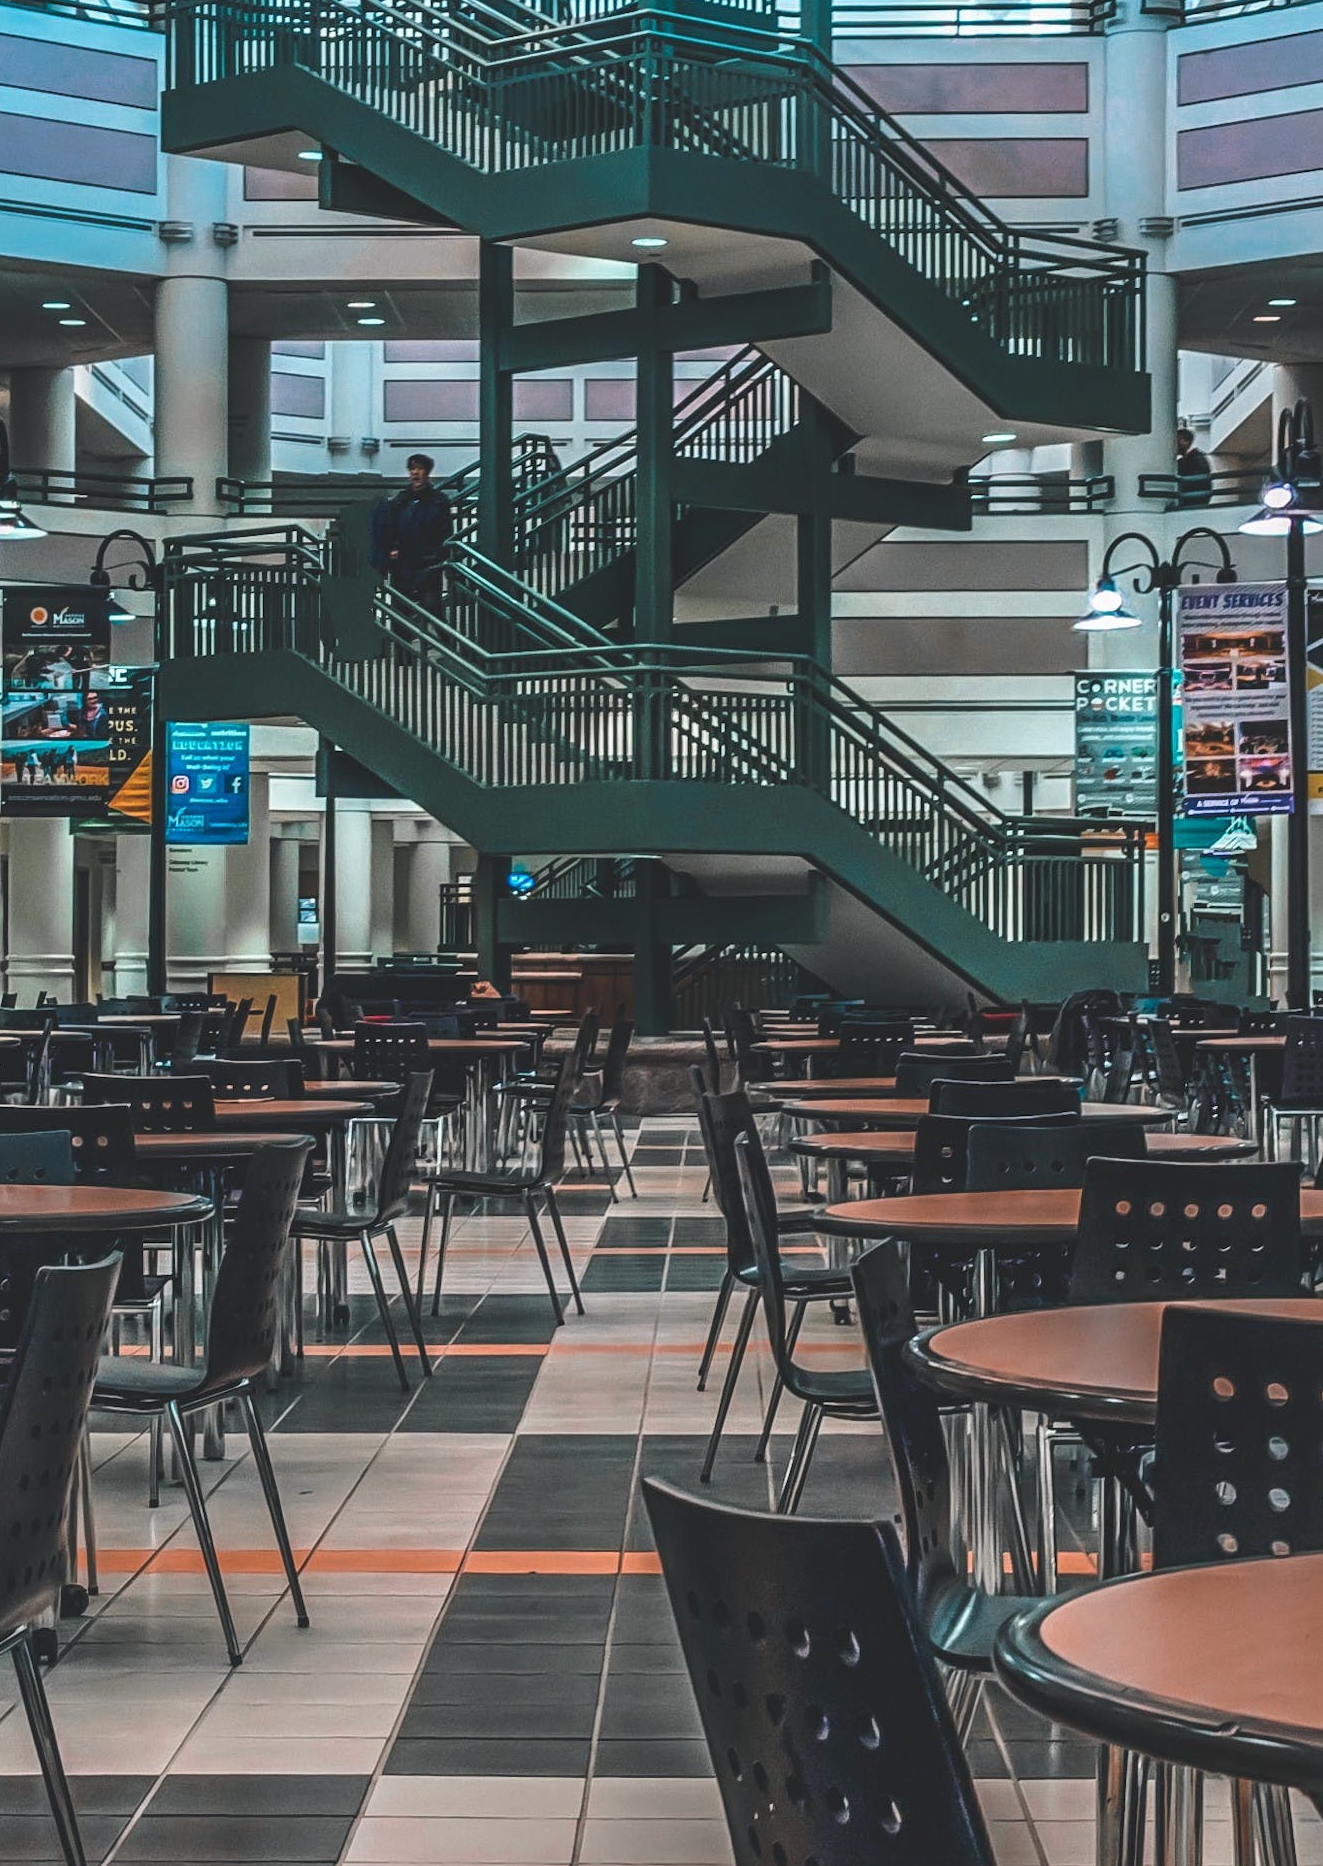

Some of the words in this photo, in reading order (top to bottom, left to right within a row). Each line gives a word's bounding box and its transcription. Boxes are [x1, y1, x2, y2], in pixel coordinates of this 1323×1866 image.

[1182, 594, 1220, 610] EVENT
[1223, 592, 1284, 609] SERVICES
[53, 612, 85, 624] MASON
[1077, 679, 1157, 694] CORNER
[1076, 696, 1157, 711] POCKET
[168, 815, 204, 828] MASON
